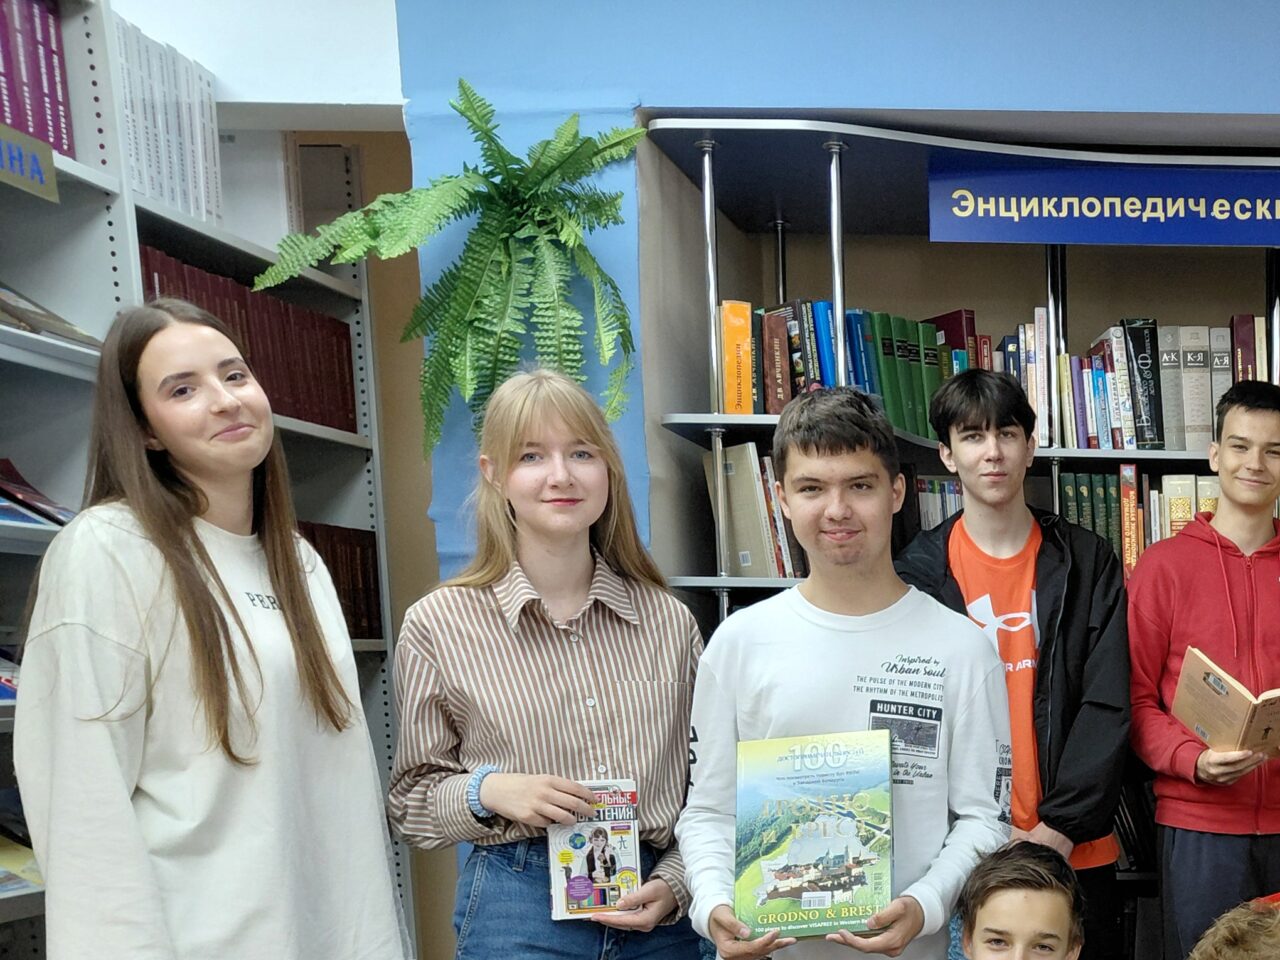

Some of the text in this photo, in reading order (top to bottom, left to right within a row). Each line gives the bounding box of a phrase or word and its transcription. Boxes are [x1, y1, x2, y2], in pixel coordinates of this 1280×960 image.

[0, 138, 46, 186] НА
[895, 654, 932, 665] Inspired
[880, 662, 946, 678] Urban Soul
[856, 675, 867, 683] THE
[868, 676, 886, 685] PULSE
[897, 679, 907, 687] THE
[908, 680, 932, 690] MODERN
[932, 684, 945, 692] CITY
[865, 686, 888, 694] RHYTHM
[910, 690, 944, 702] METROPOLIS
[876, 702, 938, 719] HUNTER CITY
[788, 741, 848, 772] 100
[757, 904, 880, 926] GRODNO & BREST
